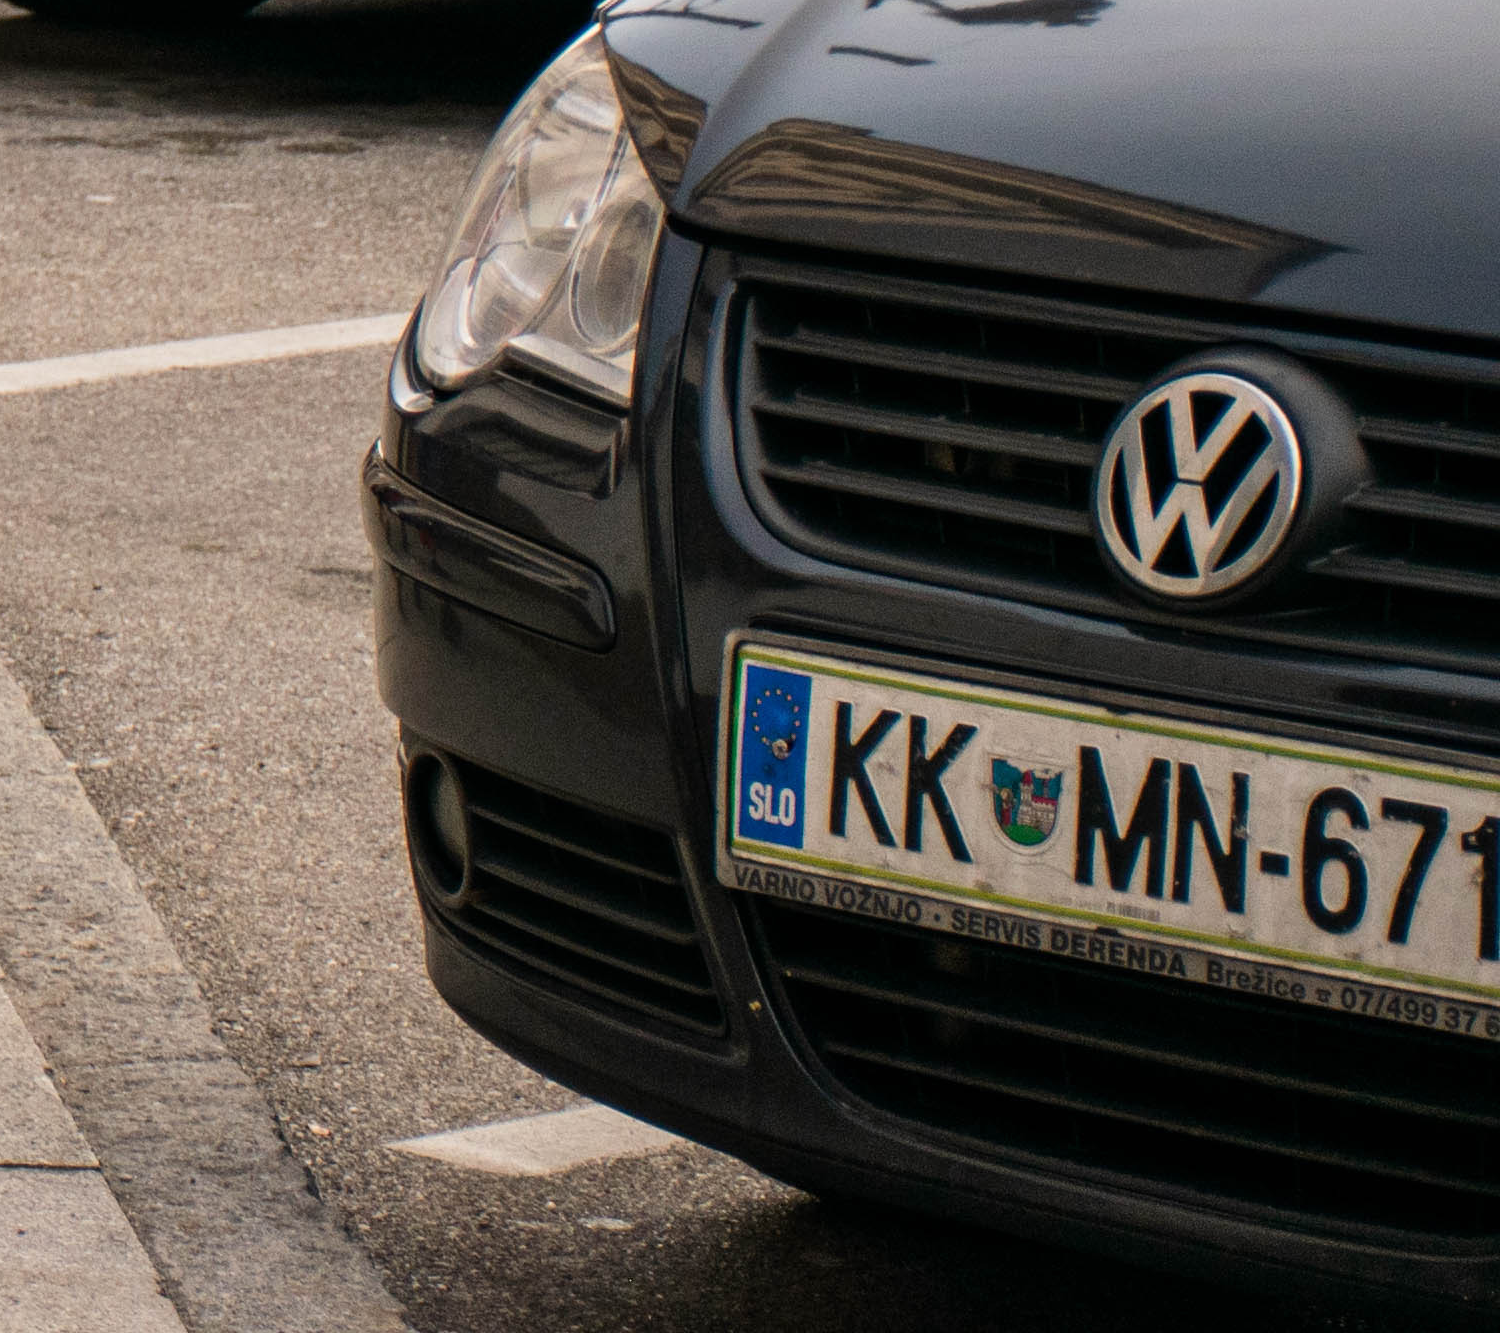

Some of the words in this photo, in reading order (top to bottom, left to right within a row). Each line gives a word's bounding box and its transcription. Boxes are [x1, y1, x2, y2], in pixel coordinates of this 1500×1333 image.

[749, 781, 797, 828] SLO
[828, 700, 979, 864] KK
[733, 864, 816, 903] VARNO
[824, 883, 922, 923] VOŽNJO
[951, 906, 1042, 950] SERVIS
[1050, 927, 1189, 978] DERENDA
[1206, 959, 1306, 1001] Brežice
[1340, 984, 1438, 1025] 07/499
[1444, 1006, 1480, 1034] 37
